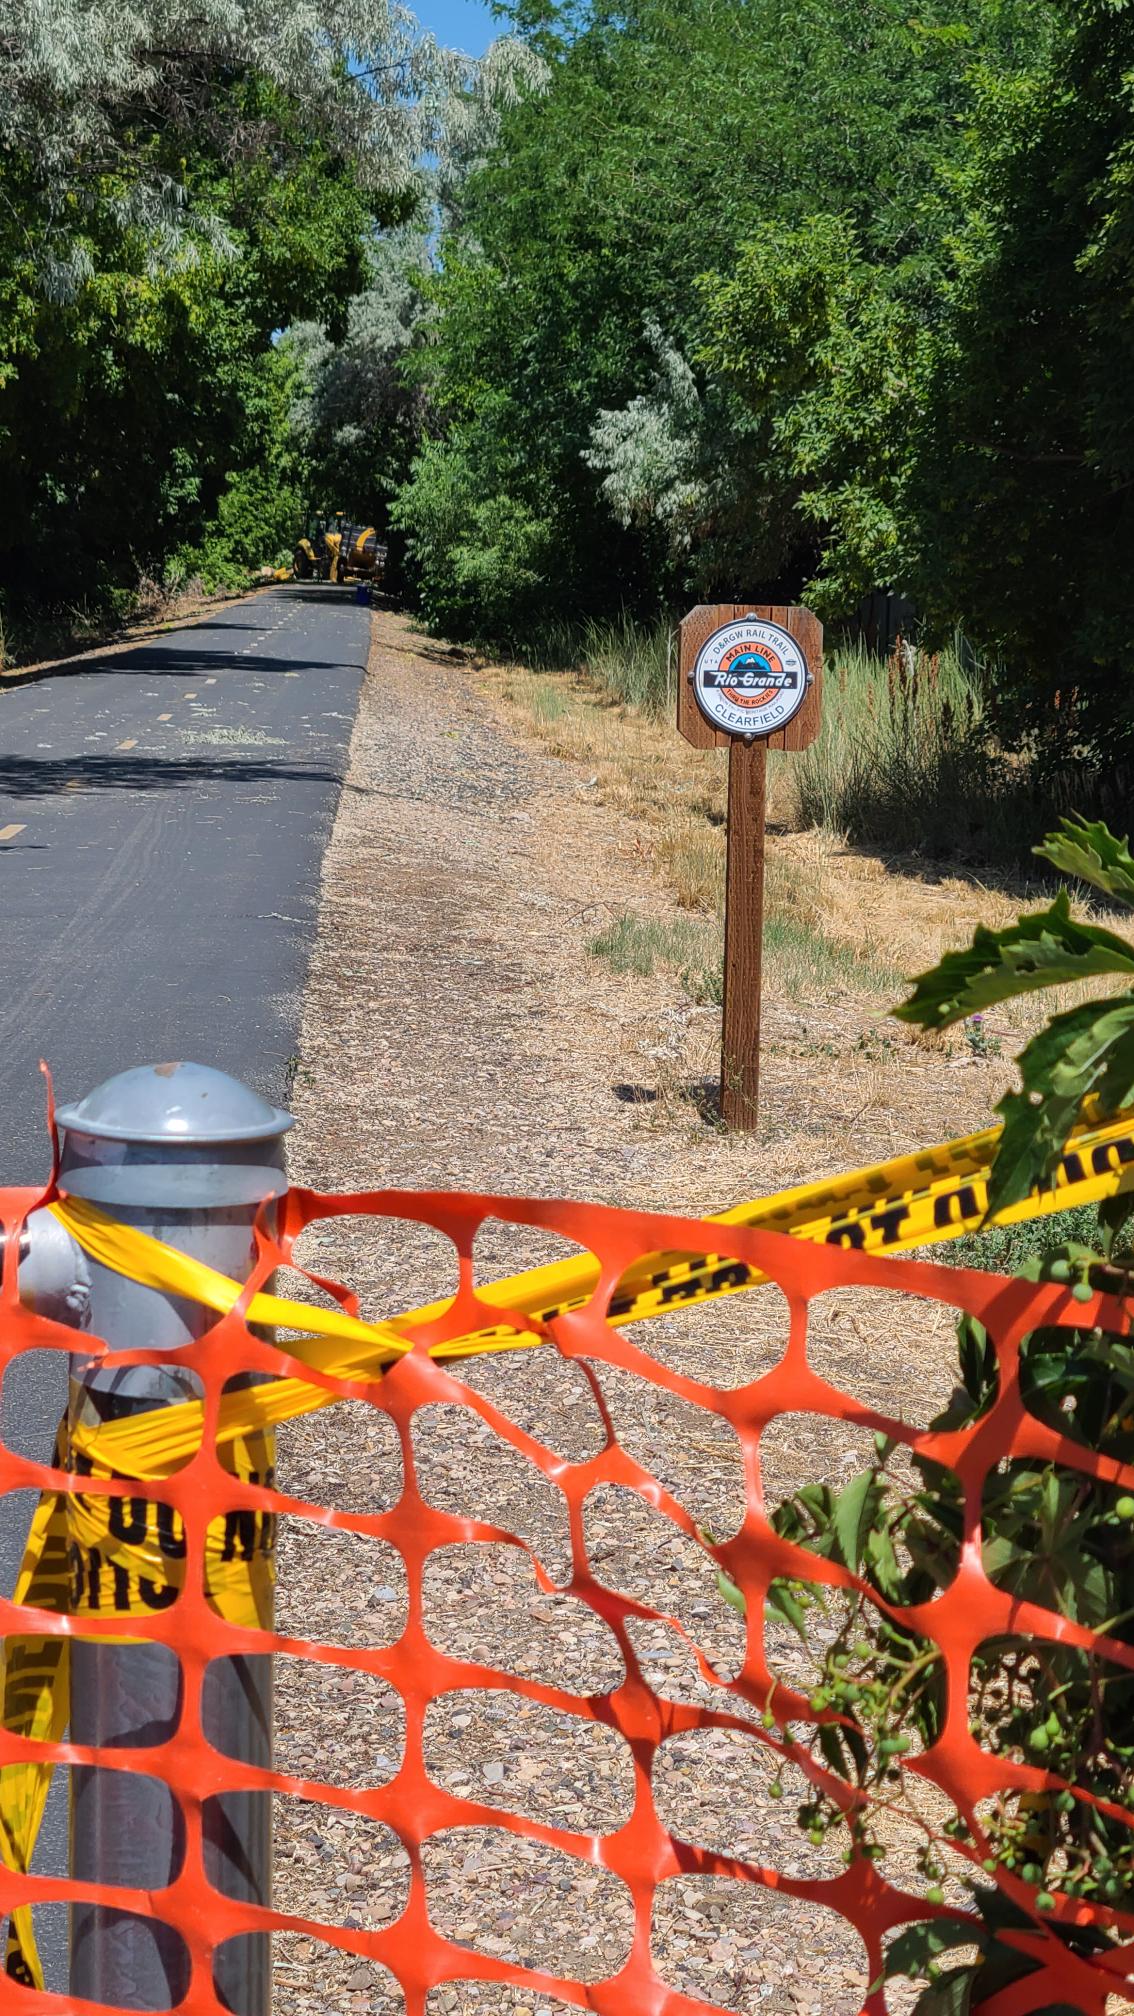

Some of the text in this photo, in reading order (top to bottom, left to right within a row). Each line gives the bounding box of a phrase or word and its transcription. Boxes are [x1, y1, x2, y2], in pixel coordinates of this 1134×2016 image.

[713, 629, 789, 656] D&RGW RAIL TRAIL
[725, 644, 776, 663] MAIN LINE
[709, 671, 793, 687] Rio Grande
[751, 690, 774, 705] ROCKIES
[715, 704, 785, 726] CLEARFIELD
